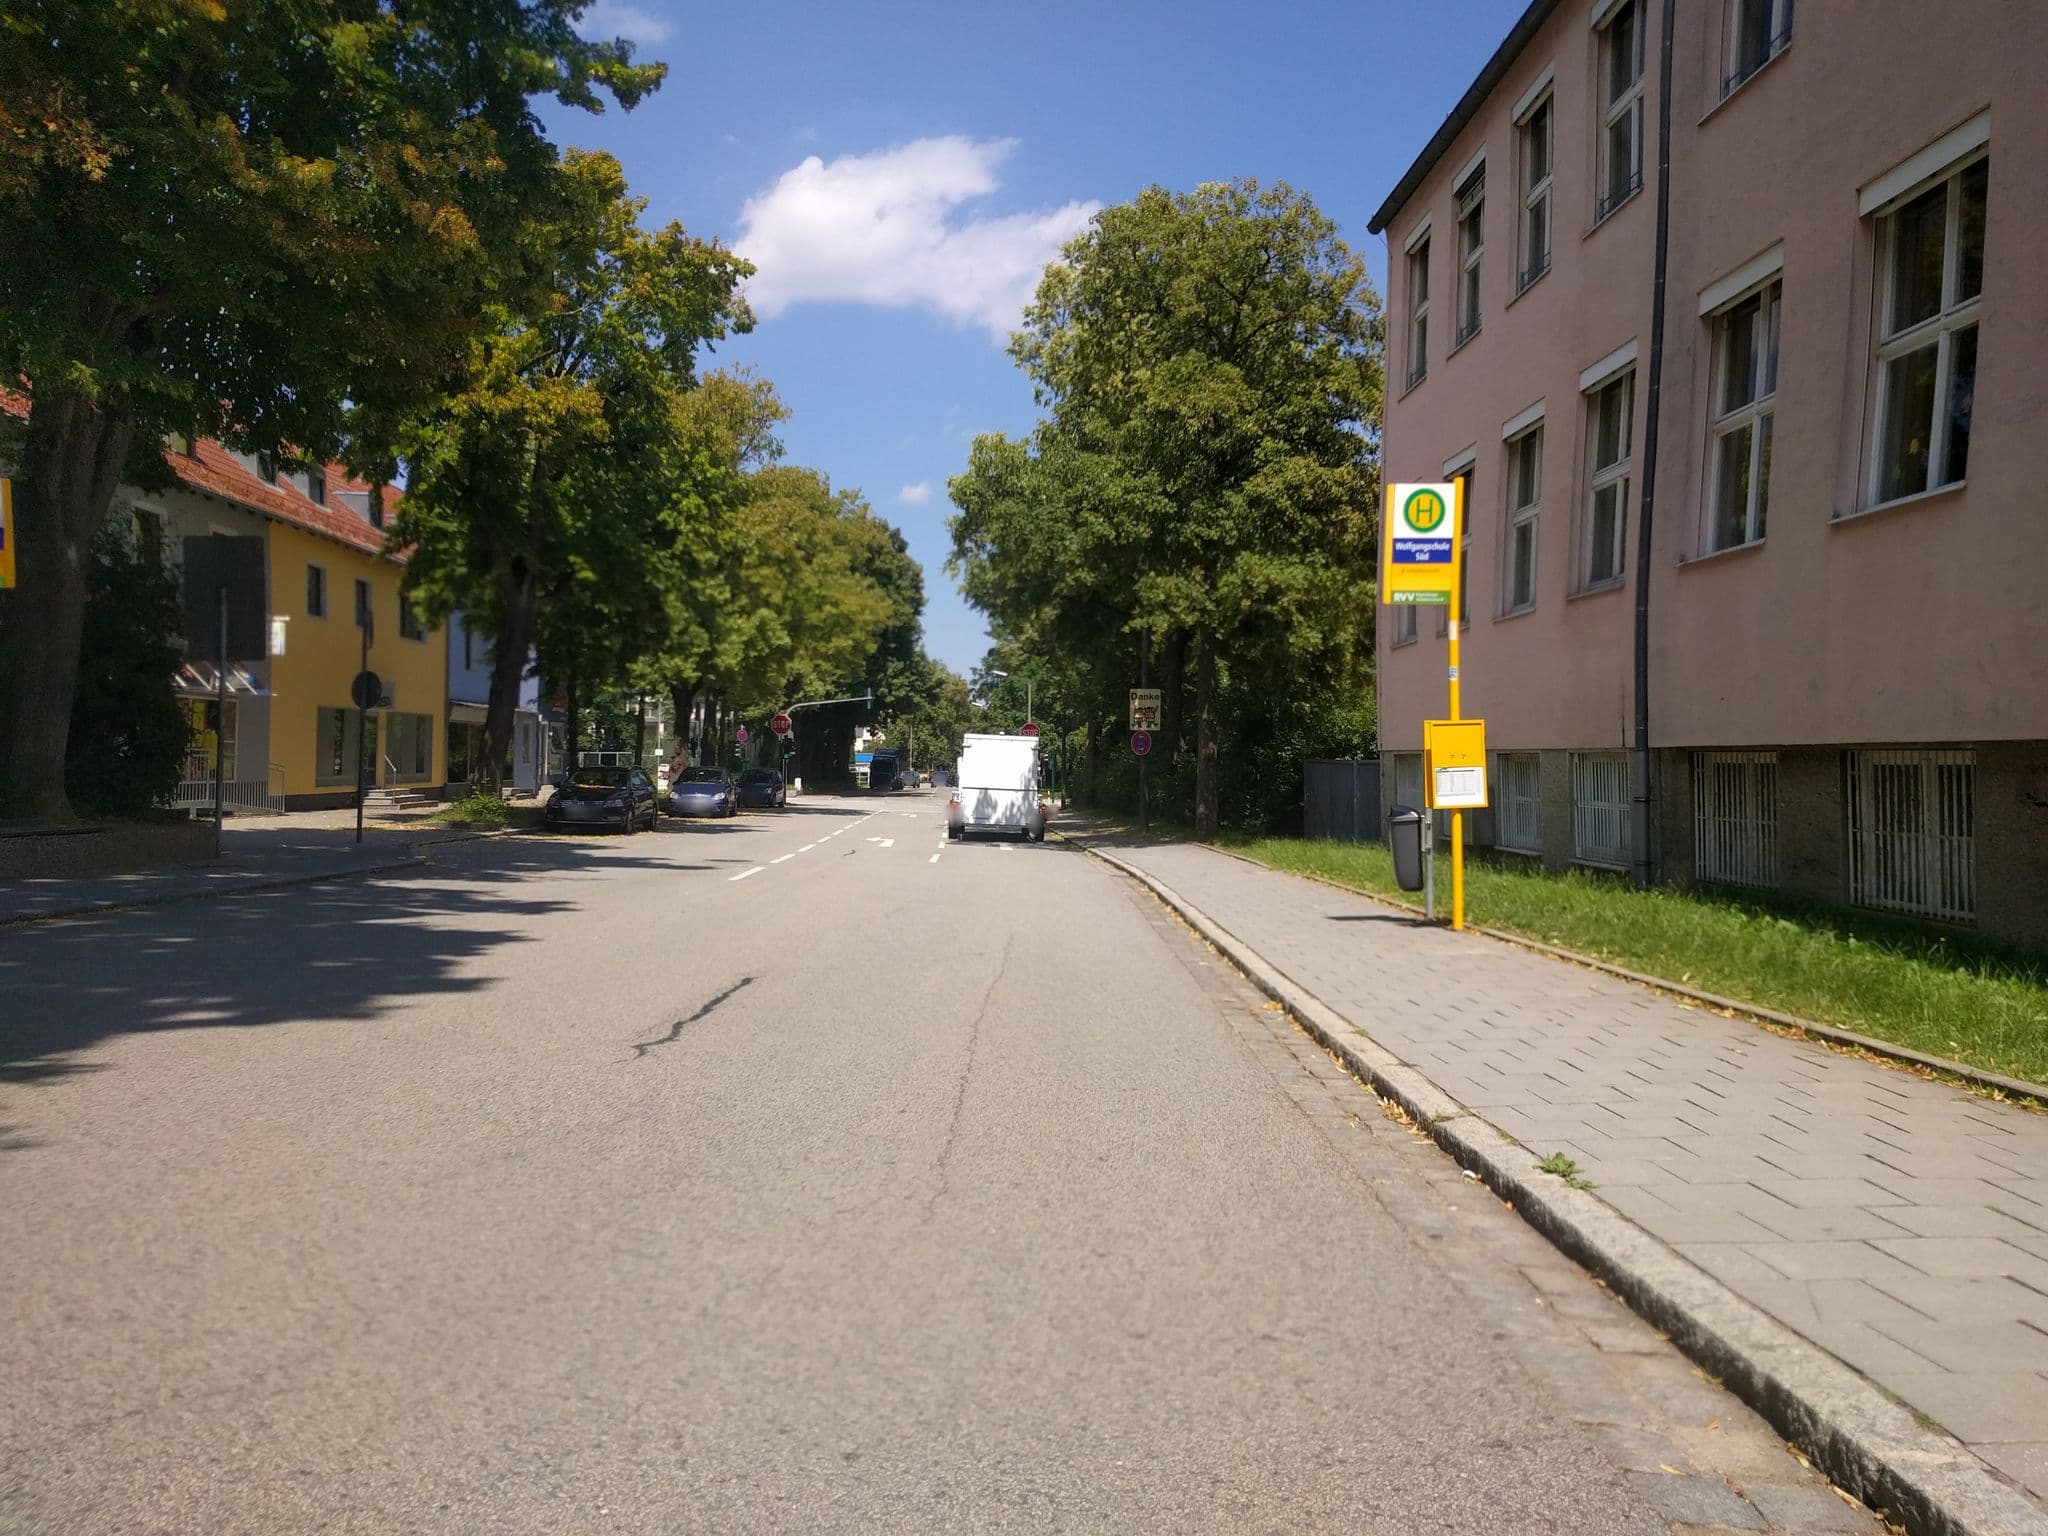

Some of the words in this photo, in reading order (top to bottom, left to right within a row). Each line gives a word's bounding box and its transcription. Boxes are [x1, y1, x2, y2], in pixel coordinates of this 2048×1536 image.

[1416, 499, 1433, 523] H
[1395, 541, 1450, 552] Wolfgangschule
[1415, 552, 1429, 561] Süd
[1394, 592, 1415, 602] RVV
[1131, 692, 1160, 701] Danke
[773, 720, 790, 729] STOP
